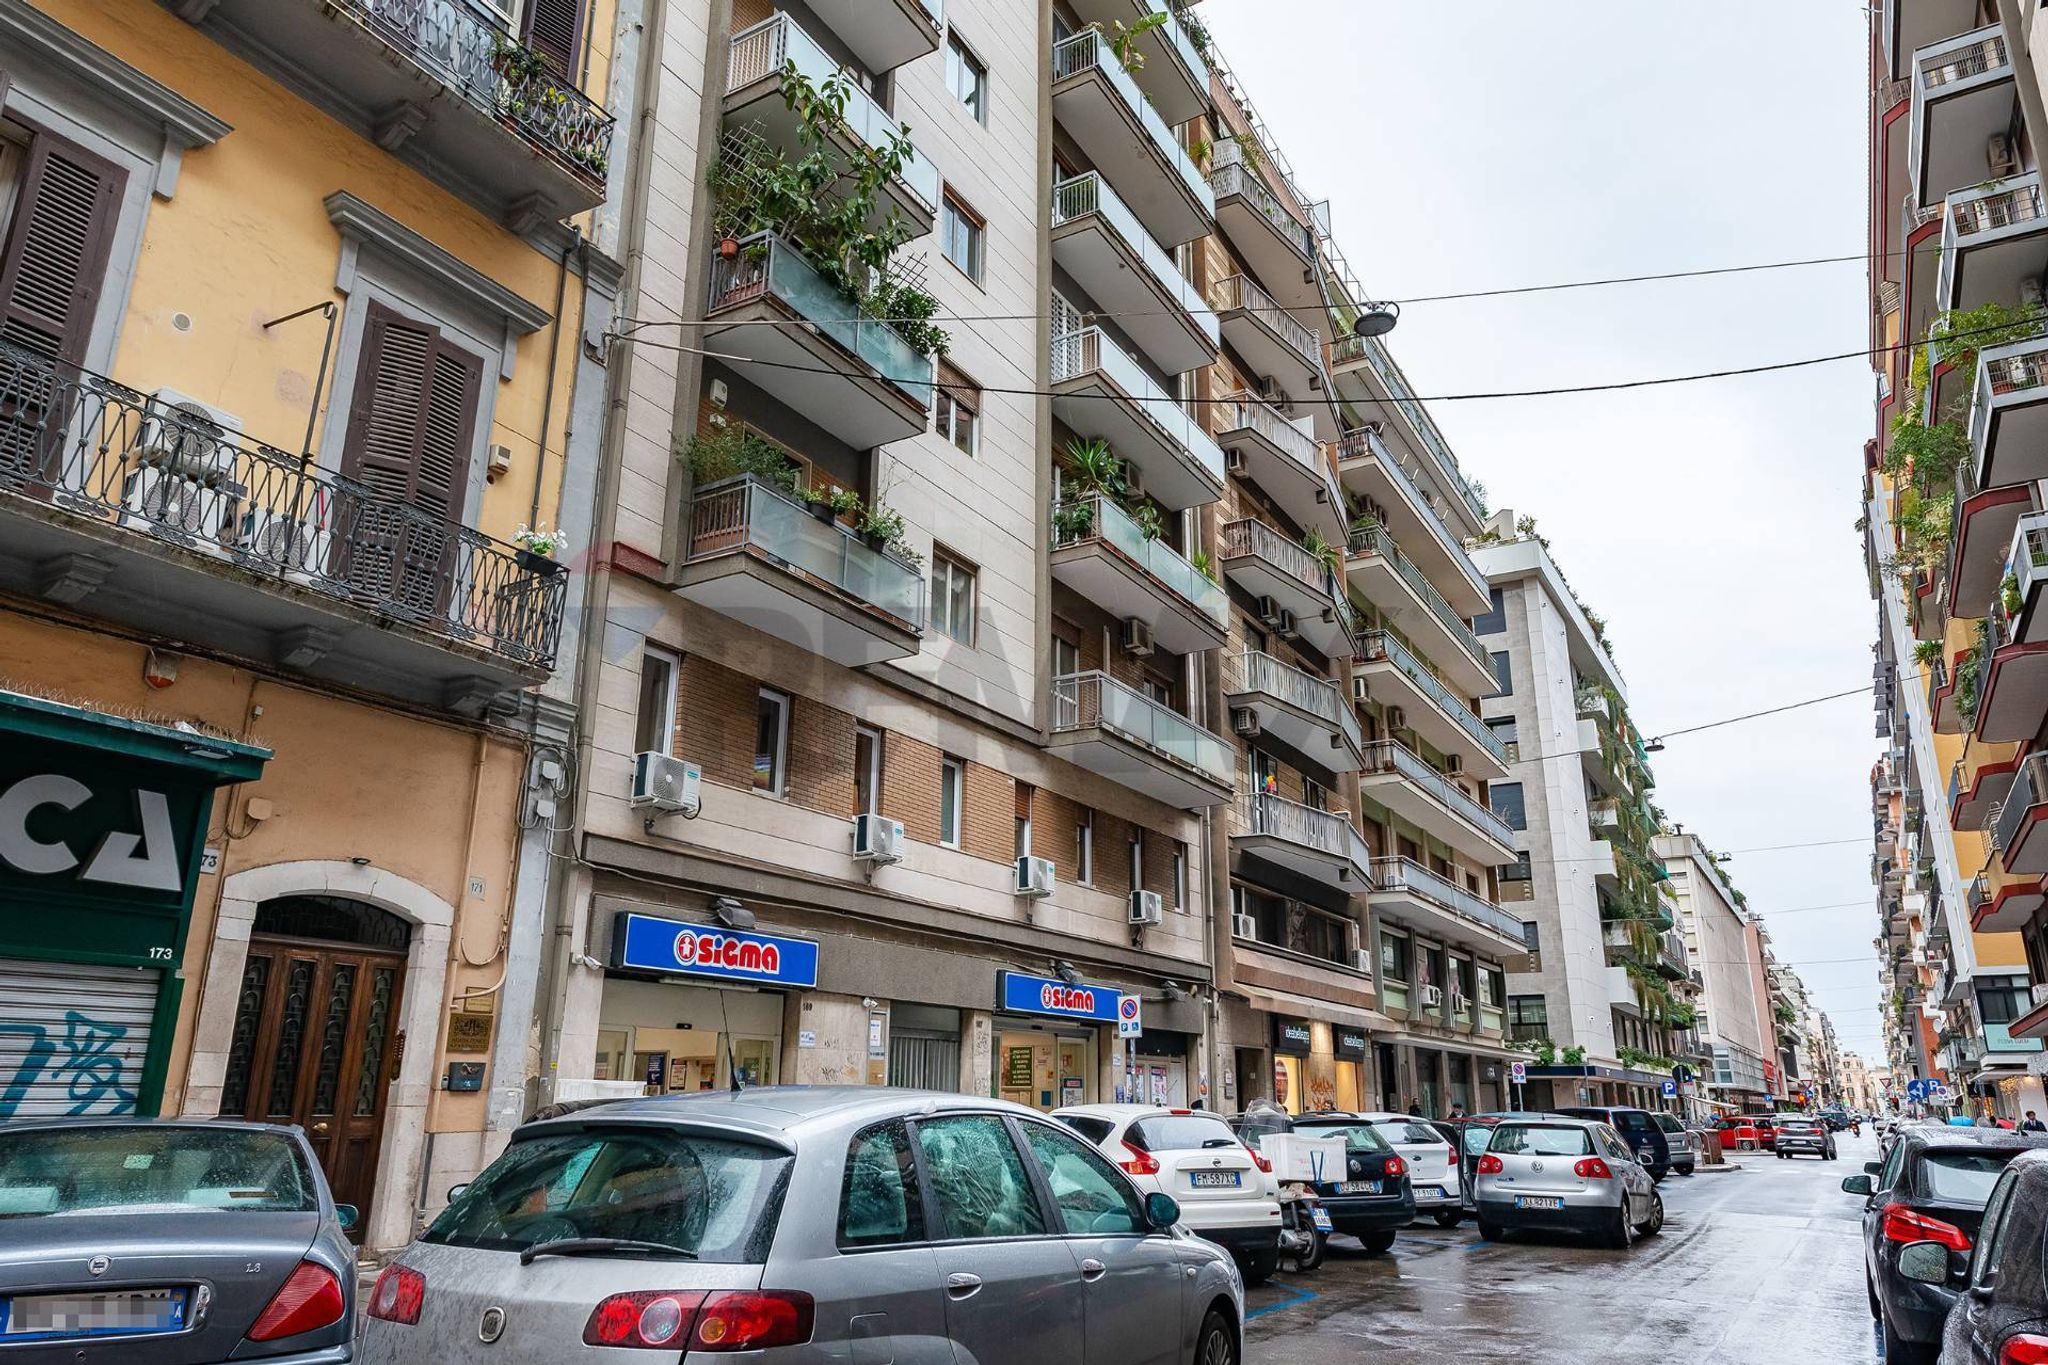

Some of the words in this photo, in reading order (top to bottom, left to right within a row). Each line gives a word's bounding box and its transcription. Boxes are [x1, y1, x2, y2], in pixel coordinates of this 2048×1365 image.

[149, 947, 173, 960] 173
[1665, 1083, 1674, 1094] P
[1929, 1081, 1939, 1090] P
